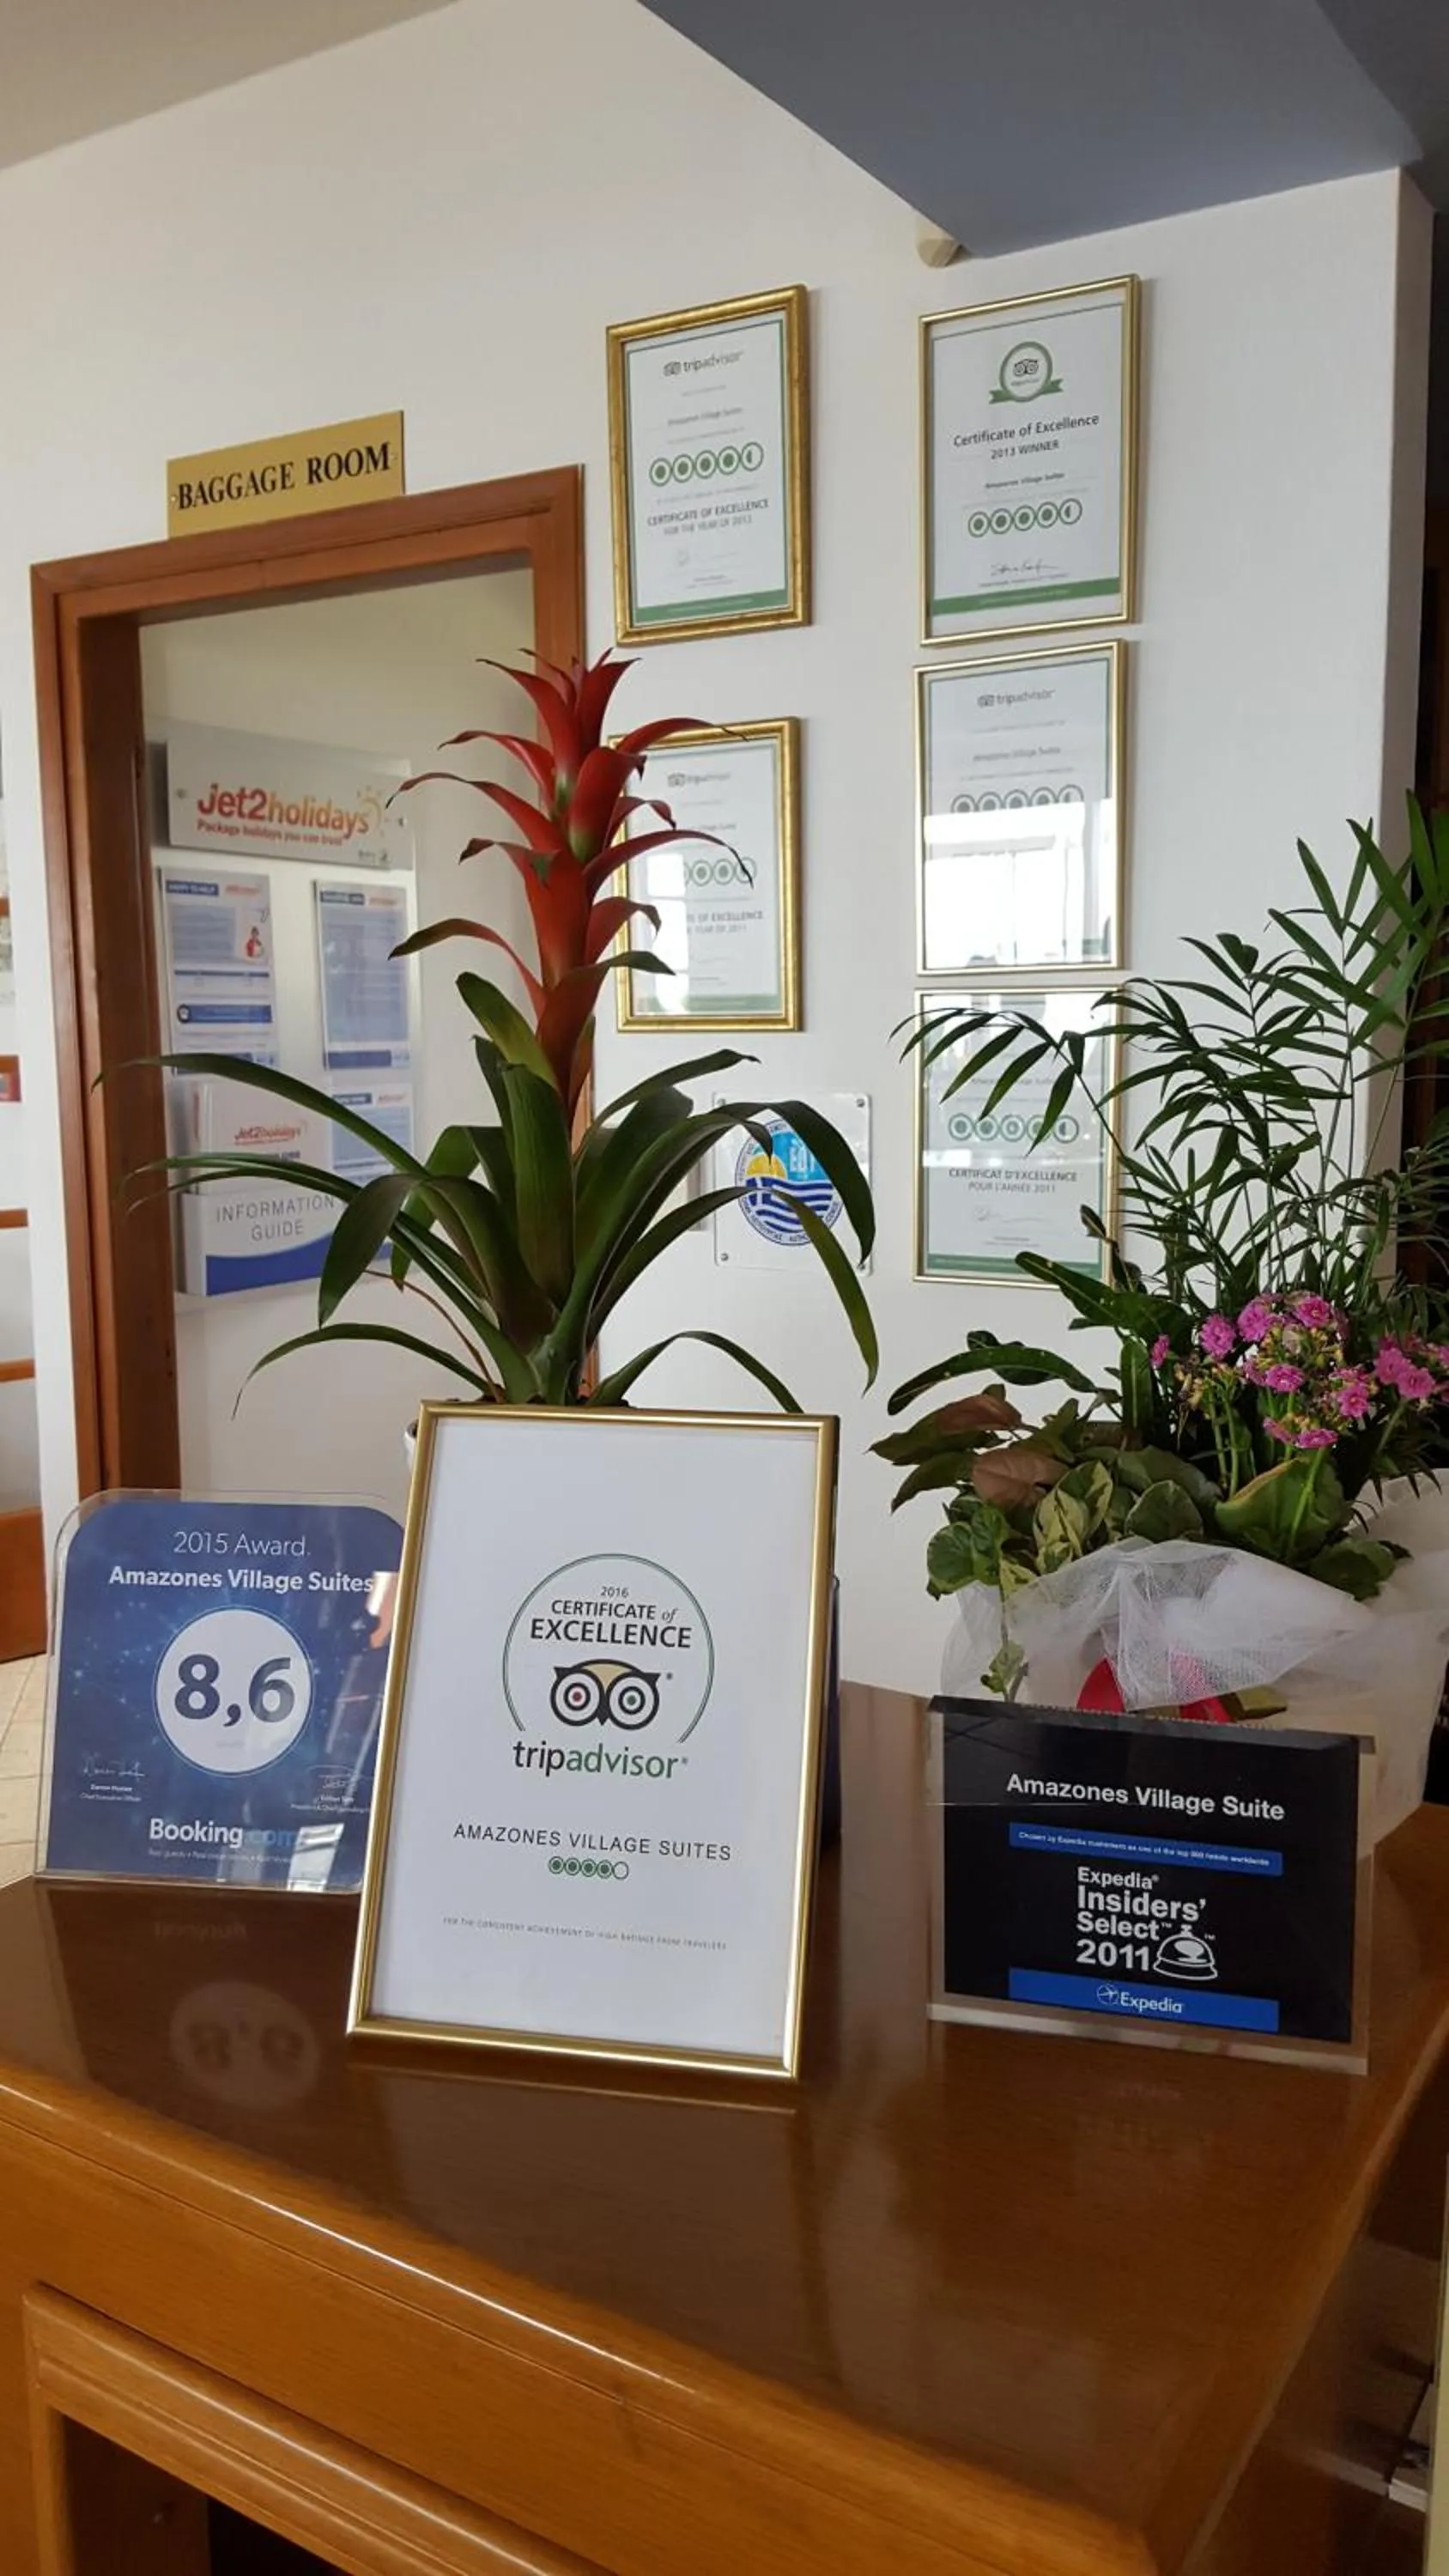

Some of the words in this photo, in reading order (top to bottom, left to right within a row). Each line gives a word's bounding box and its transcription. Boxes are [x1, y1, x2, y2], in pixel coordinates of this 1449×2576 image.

[954, 428, 1016, 447] Certificate
[1019, 422, 1033, 437] of
[1036, 415, 1100, 434] Excellence
[991, 446, 1016, 459] 2013
[1019, 439, 1059, 454] WINNER
[178, 461, 294, 509] BAGGAGE
[306, 441, 391, 485] ROOM
[647, 508, 698, 526] CERTIFICATE
[700, 507, 712, 519] OF
[715, 498, 769, 515] EXCELLENCE
[197, 818, 239, 835] Package
[242, 824, 282, 840] holidays
[284, 831, 300, 842] you
[949, 1168, 1002, 1179] CERTIFICAT
[1005, 1170, 1077, 1182] D'EXCELLENCE
[216, 1194, 336, 1223] INFORMATION
[252, 1220, 304, 1242] GUIDE
[173, 1531, 229, 1554] 2015
[109, 1565, 221, 1588] Amazones
[227, 1570, 303, 1595] Village
[308, 1573, 373, 1593] Suites
[601, 1586, 628, 1598] 2016
[551, 1600, 656, 1619] CERTIFICATE
[662, 1607, 678, 1623] of
[530, 1618, 692, 1649] EXCELLENCE
[174, 1654, 295, 1728] 8,6
[1006, 1773, 1129, 1804] Amazones
[1135, 1787, 1215, 1814] Village
[1222, 1795, 1285, 1820] Suite
[453, 1823, 561, 1847] AMAZONES
[569, 1832, 650, 1854] VILLAGE
[659, 1840, 731, 1861] SUITES
[1076, 1938, 1149, 1972] 2011
[1119, 1990, 1183, 2015] Expedia
